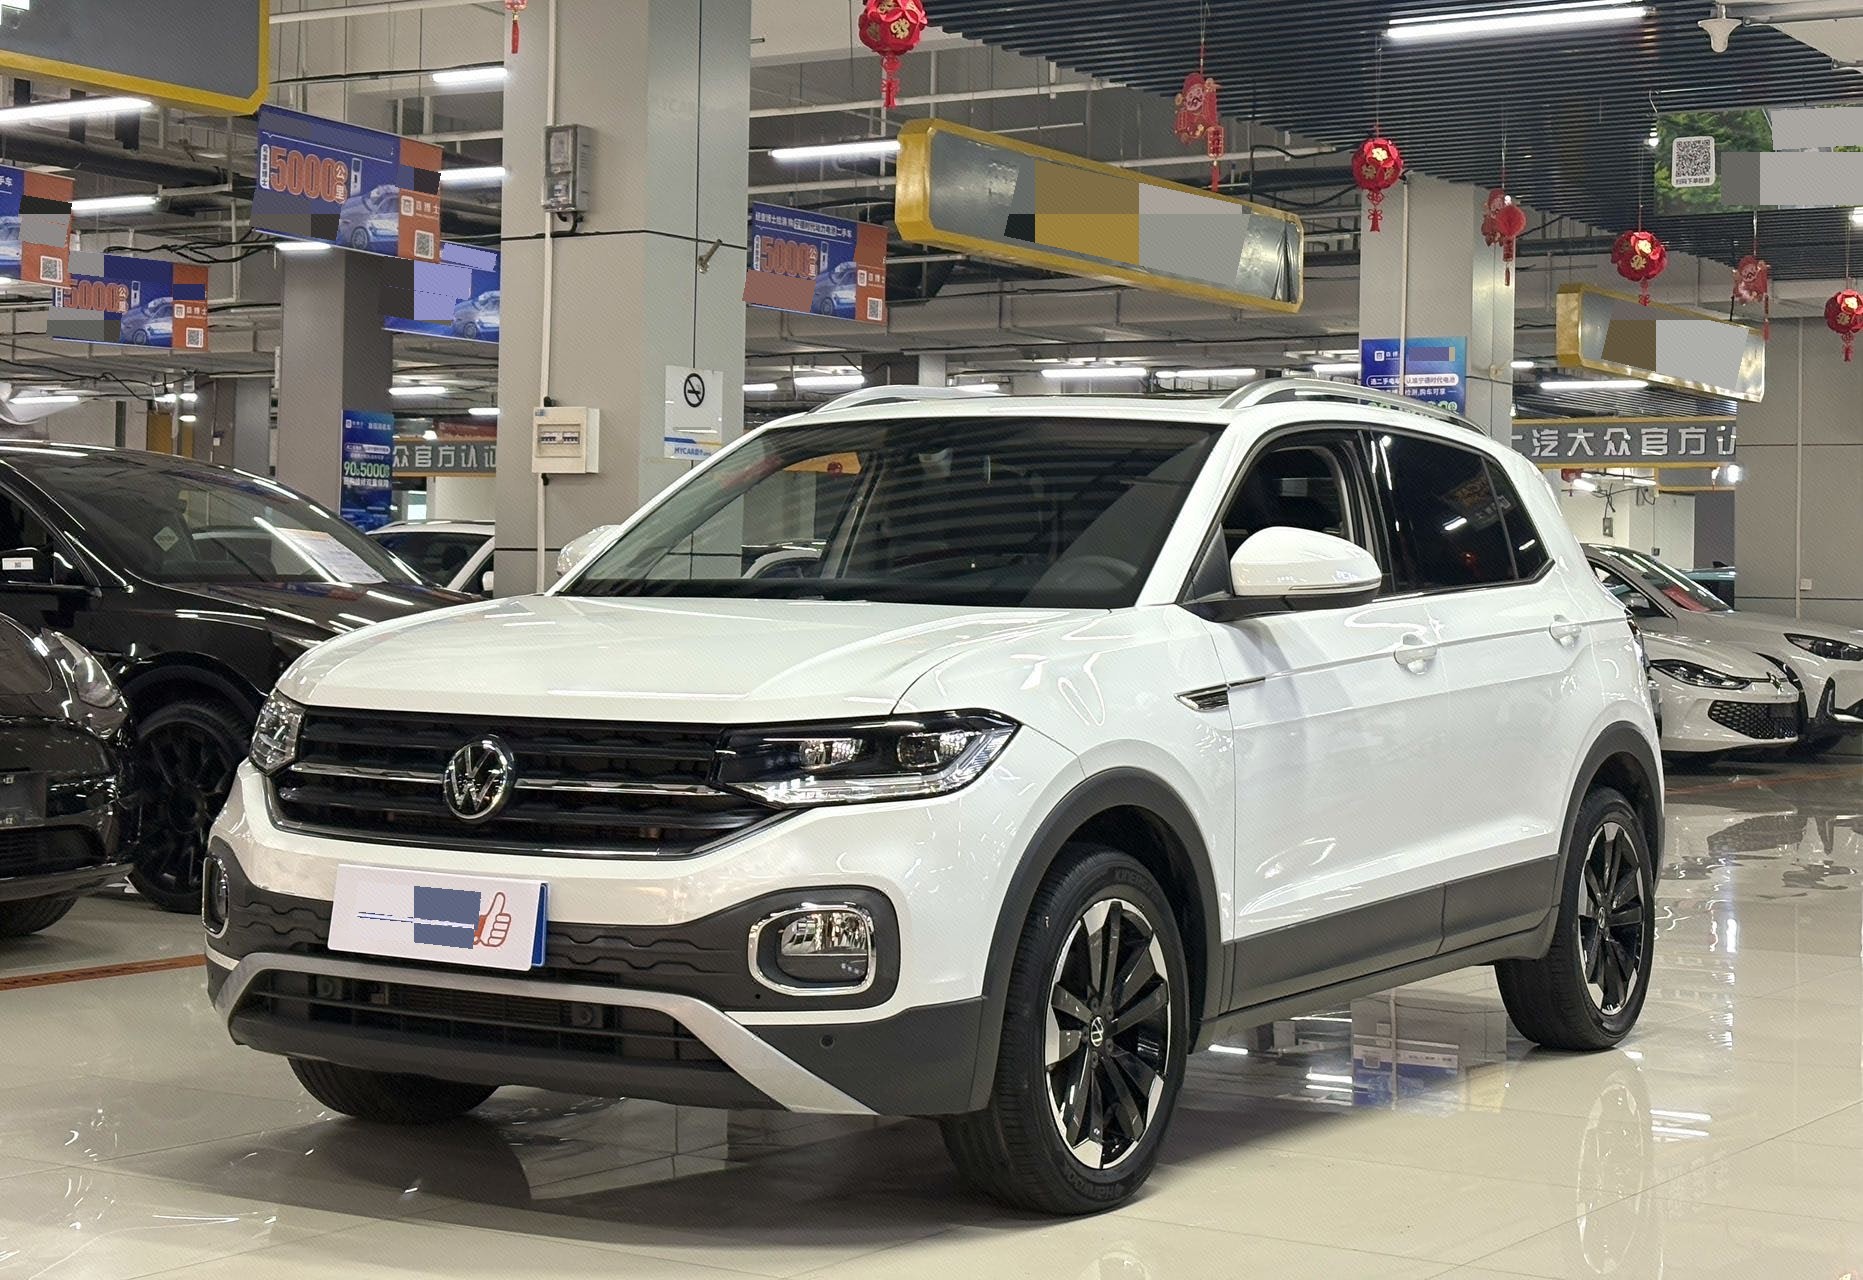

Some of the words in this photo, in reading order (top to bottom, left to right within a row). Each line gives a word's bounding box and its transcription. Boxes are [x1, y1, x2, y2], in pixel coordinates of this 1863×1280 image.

[270, 145, 338, 202] 5000
[334, 163, 347, 203] 公里
[808, 246, 818, 279] 公里
[1512, 427, 1736, 457] 汽大众官方认
